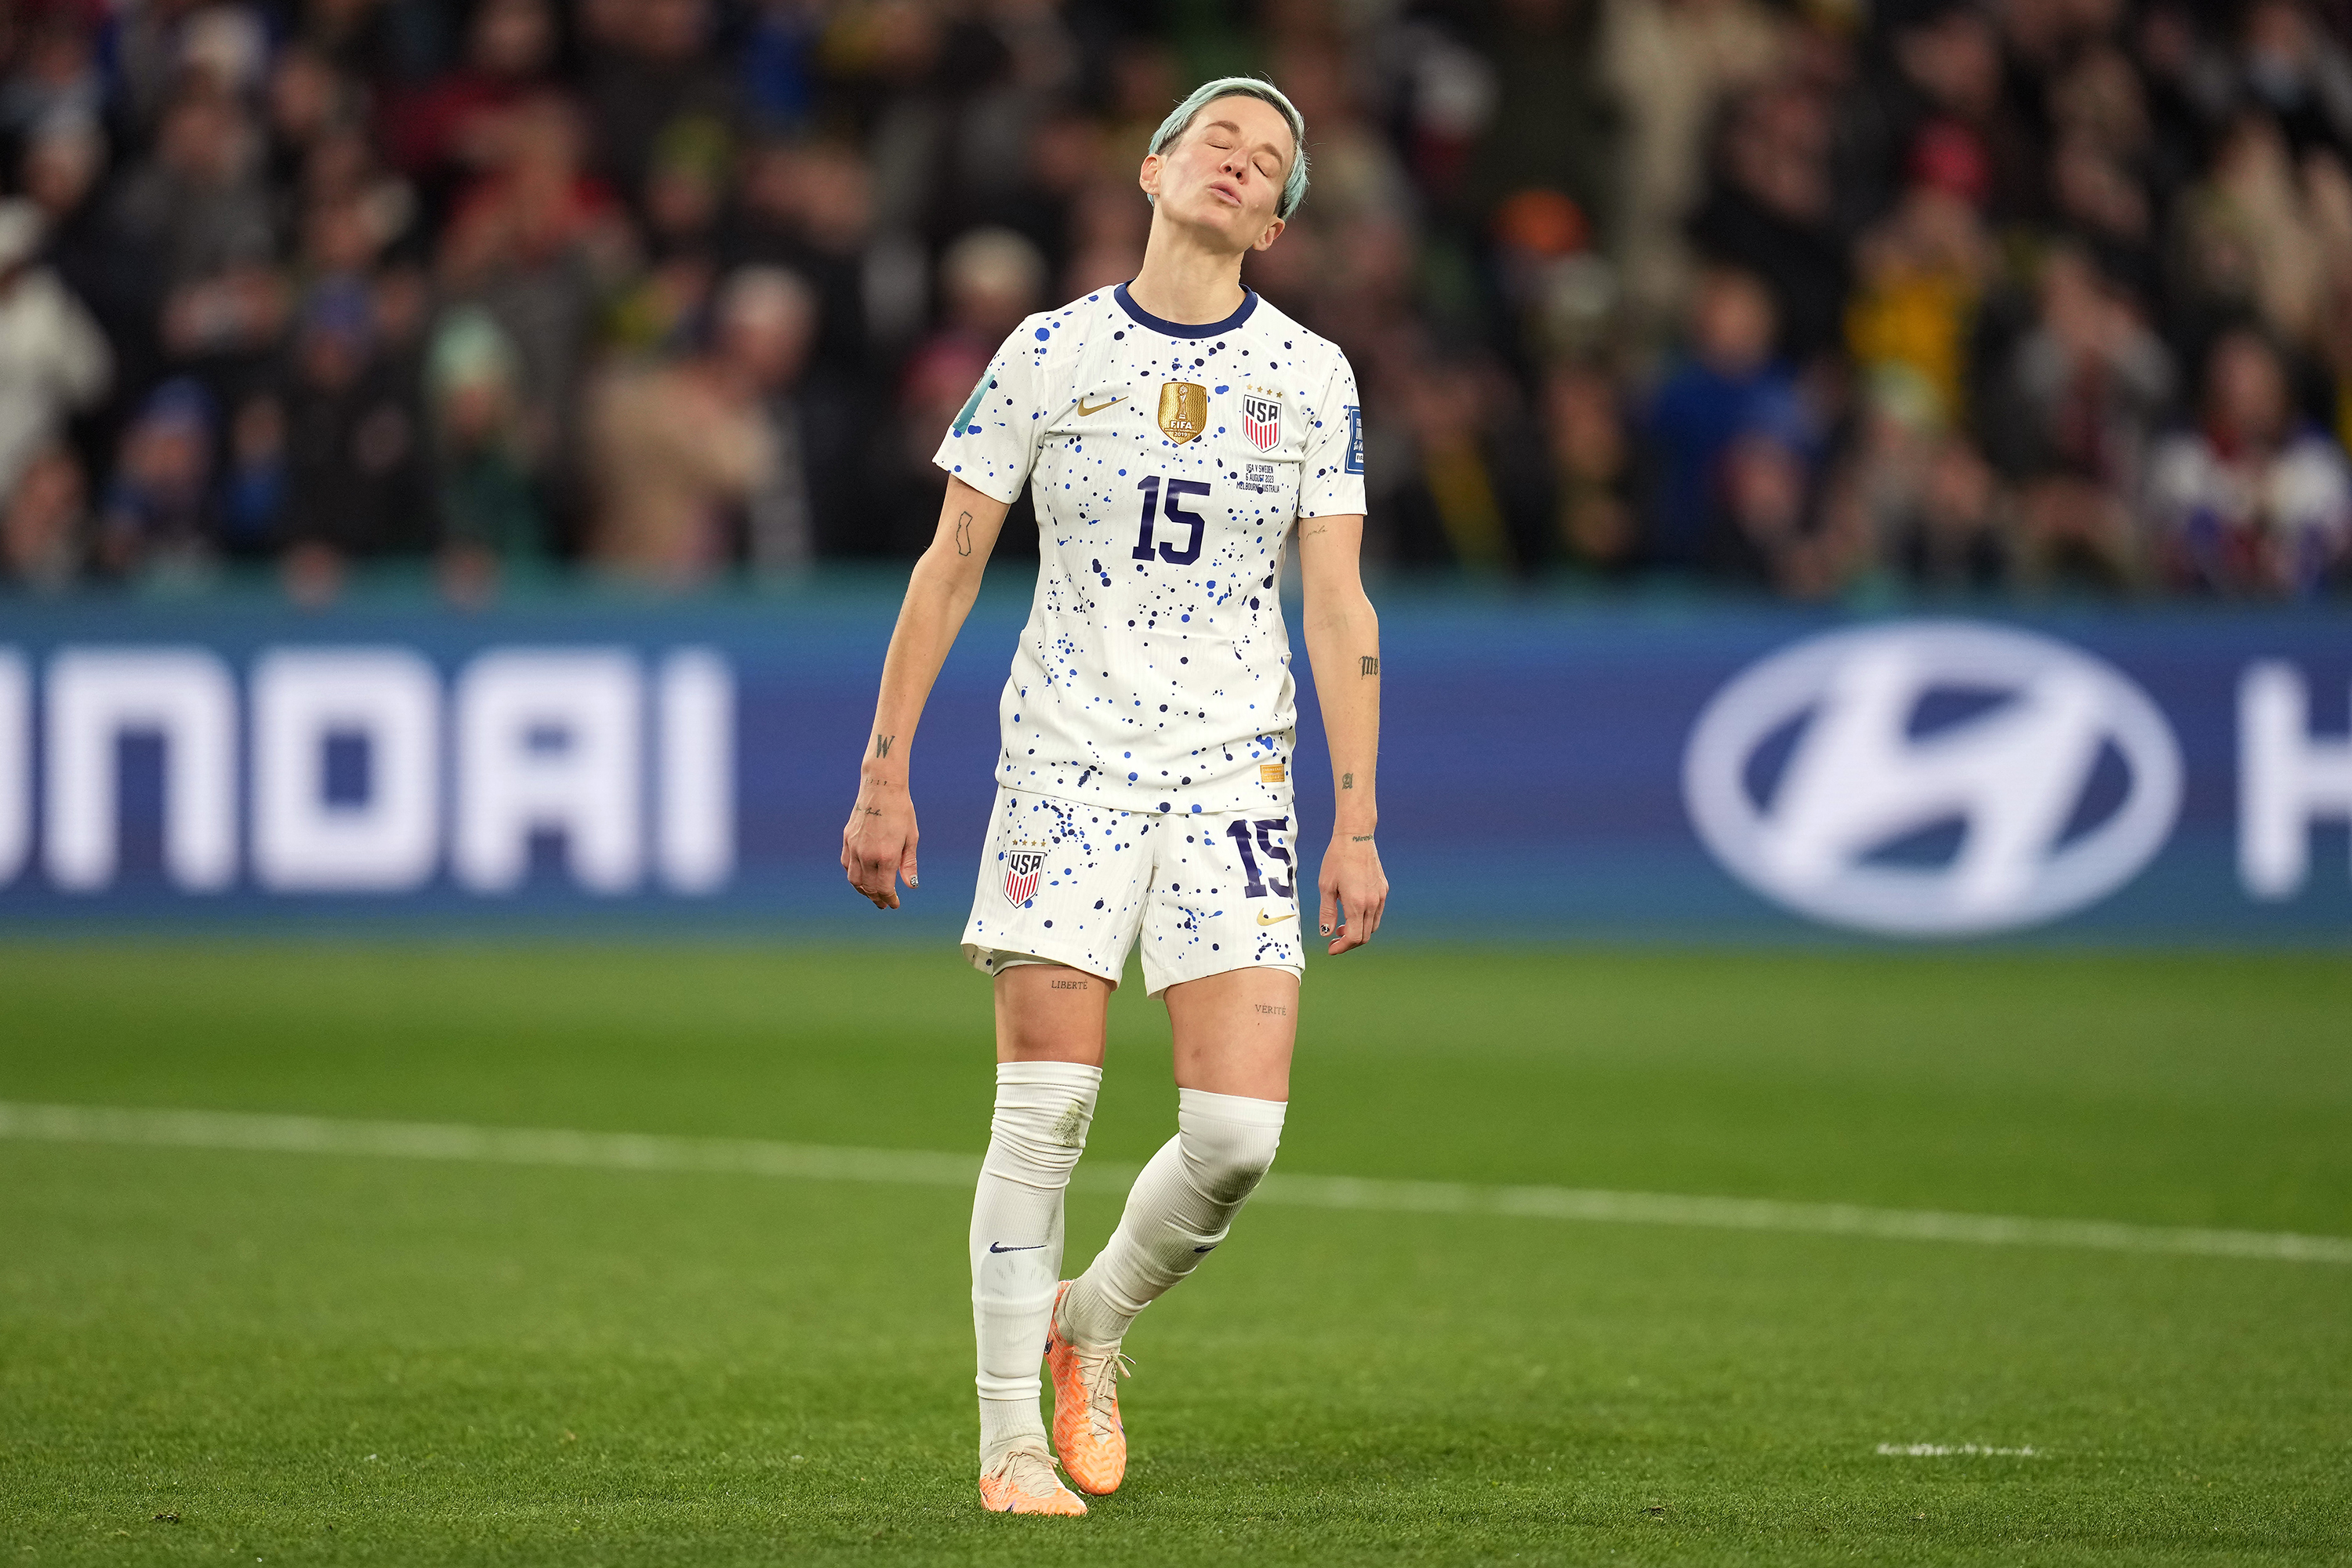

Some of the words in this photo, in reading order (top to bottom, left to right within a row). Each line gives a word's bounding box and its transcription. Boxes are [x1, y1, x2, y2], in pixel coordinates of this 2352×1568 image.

[1246, 399, 1278, 423] USA
[1171, 420, 1192, 429] FIFA
[1258, 465, 1274, 474] SWEDEN
[1250, 474, 1265, 482] AUGUST
[1265, 474, 1274, 483] 2023
[1132, 475, 1211, 565] 15
[0, 644, 737, 894] NDAI
[1011, 854, 1042, 875] USA
[1226, 819, 1294, 899] 15
[1051, 979, 1088, 989] LIBERTÉ
[1255, 1003, 1287, 1016] VÉRITÉ
